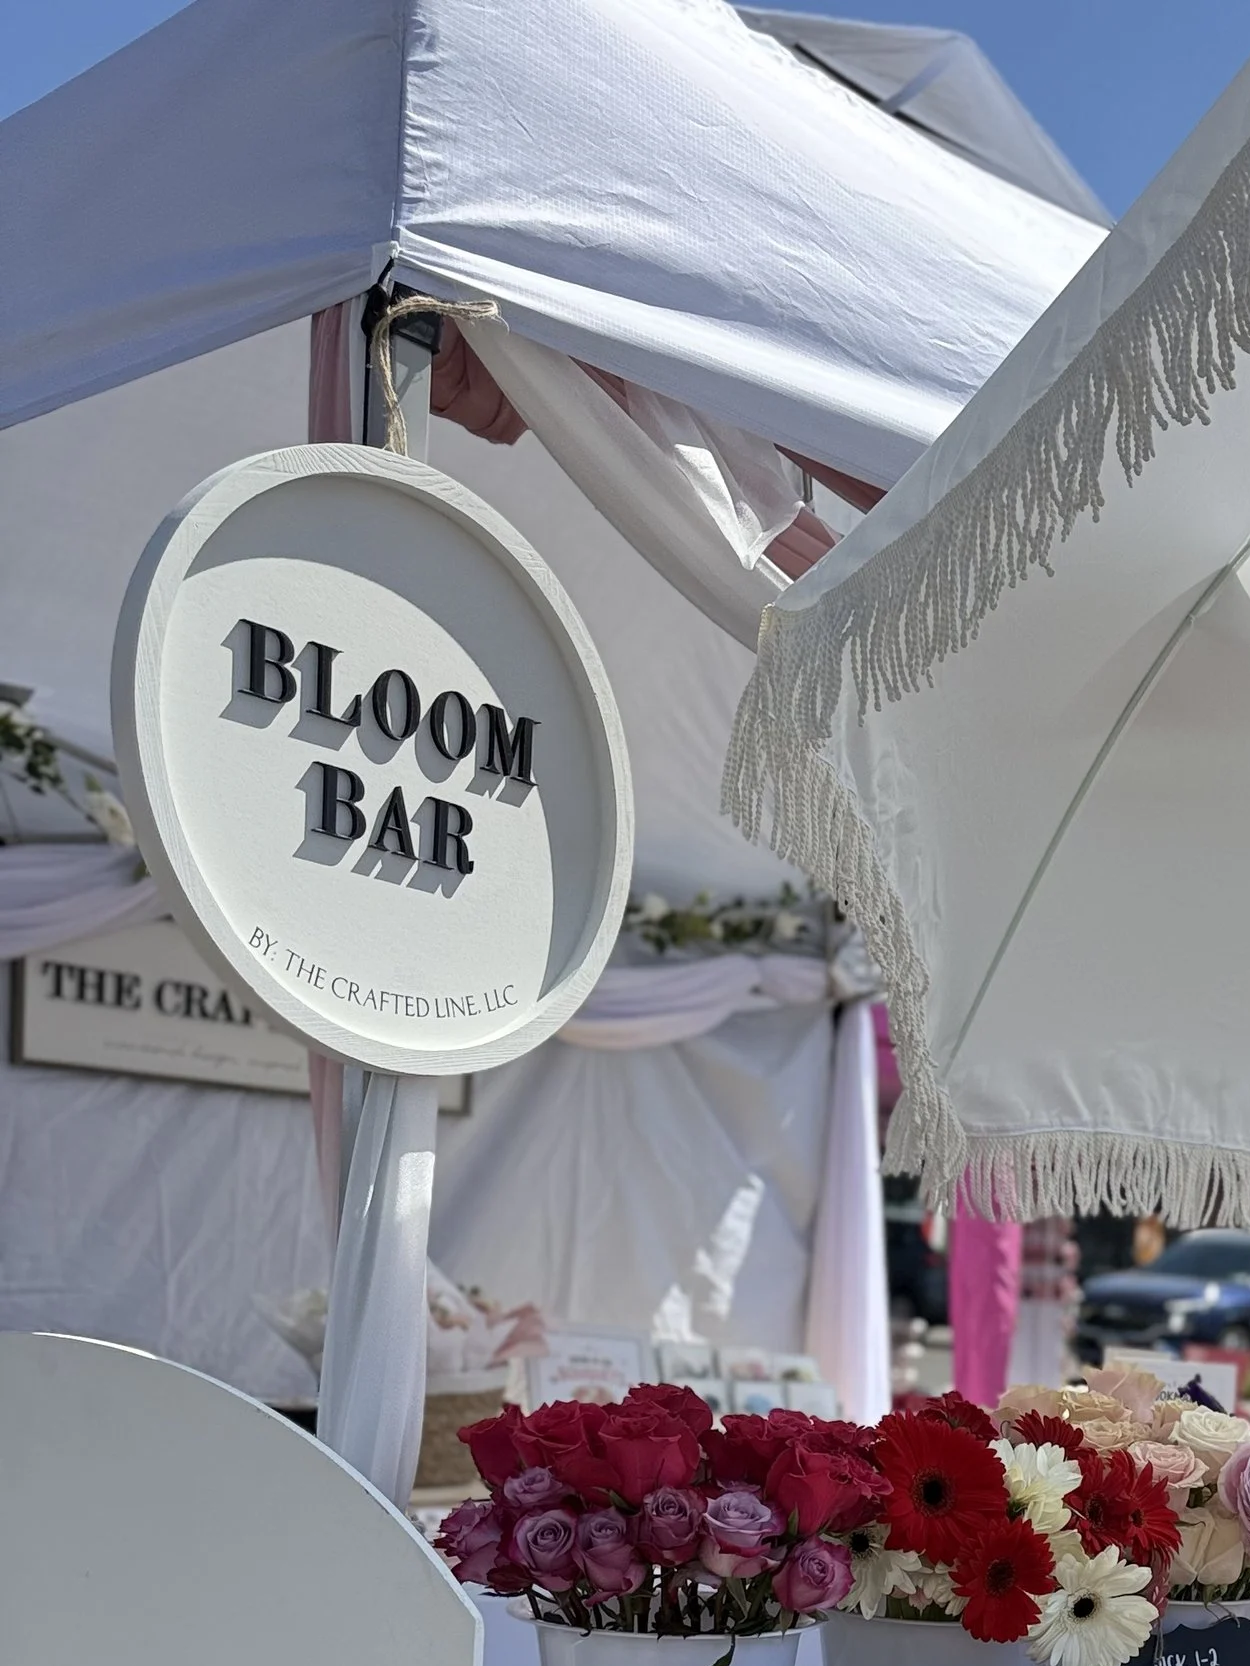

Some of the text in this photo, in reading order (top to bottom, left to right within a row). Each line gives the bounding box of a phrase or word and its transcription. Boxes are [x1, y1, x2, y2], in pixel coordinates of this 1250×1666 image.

[237, 617, 542, 787] BLOOM
[310, 760, 476, 876] BAR
[42, 960, 142, 1010] THE
[248, 925, 279, 962] BY:
[285, 948, 328, 991] THE
[331, 976, 430, 1019] CRAFTED
[483, 983, 519, 1013] LLC
